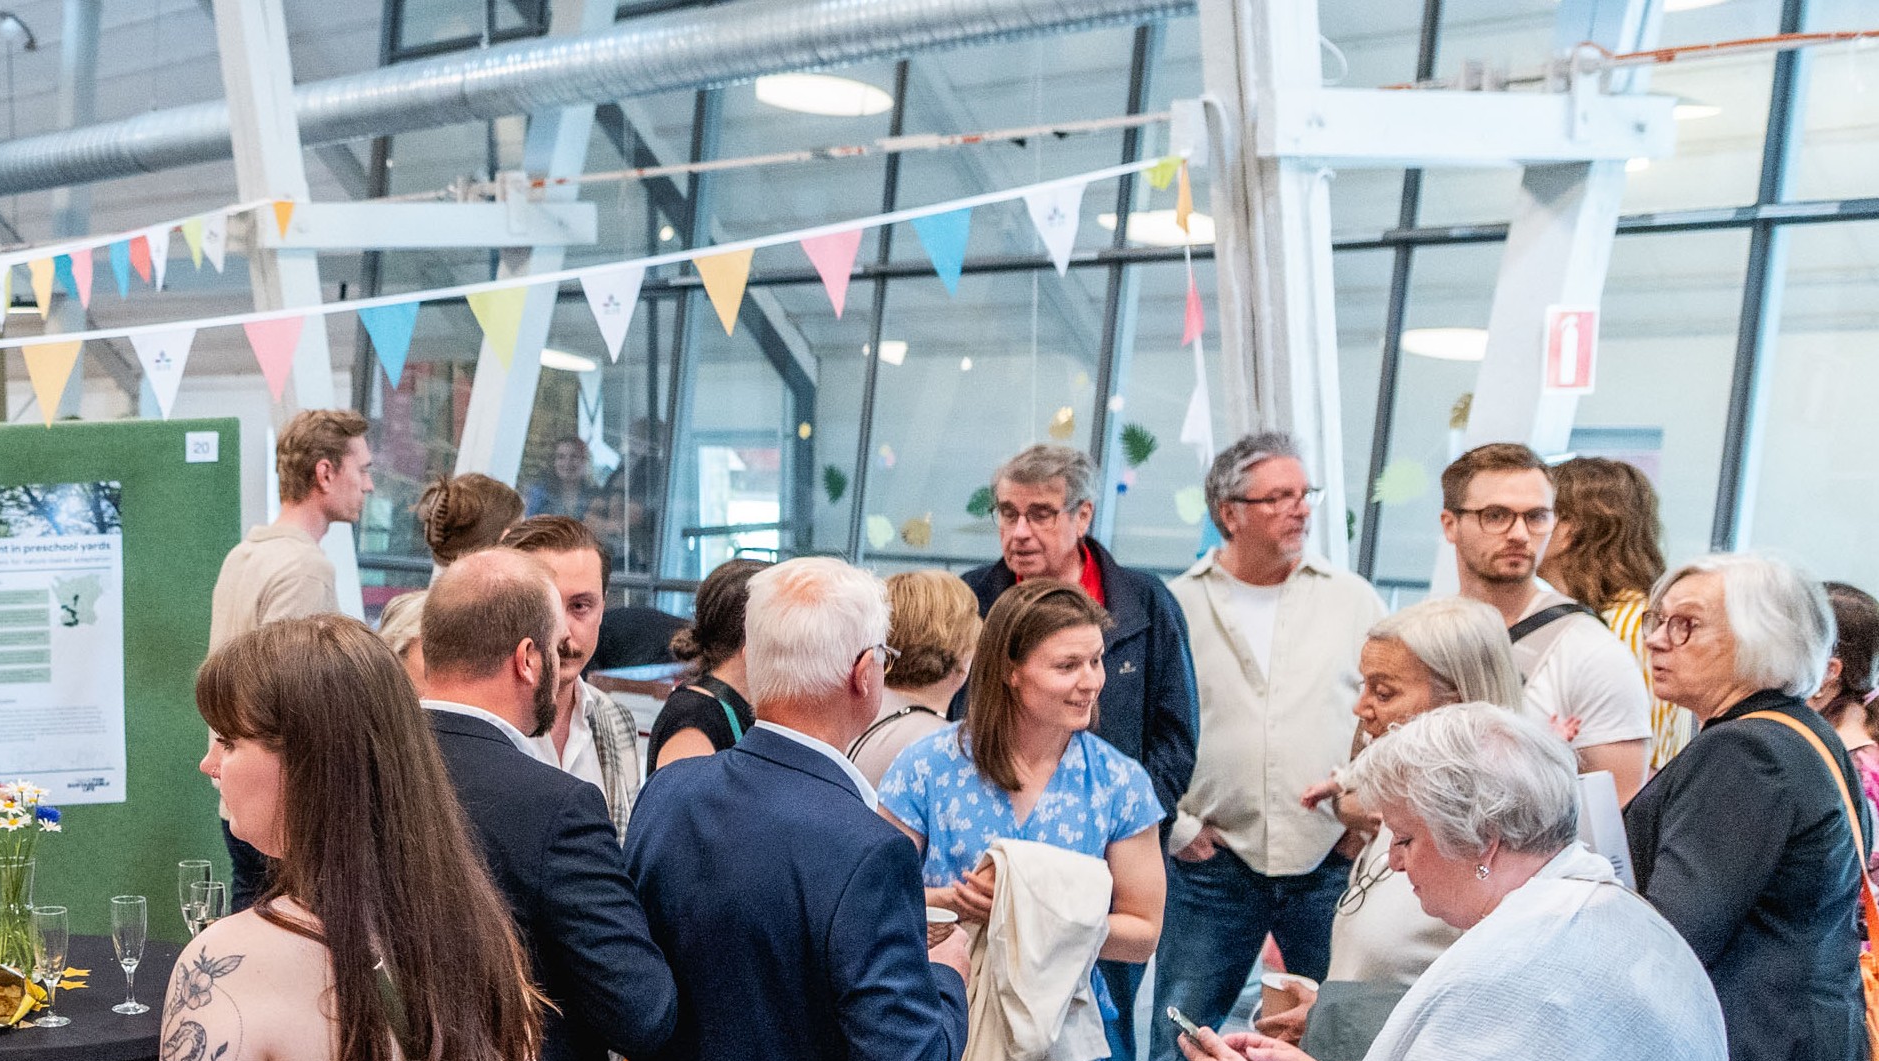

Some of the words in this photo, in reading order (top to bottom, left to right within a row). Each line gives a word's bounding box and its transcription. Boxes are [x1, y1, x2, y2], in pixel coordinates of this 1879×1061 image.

[193, 441, 210, 454] 20
[24, 543, 78, 554] preschool
[81, 542, 111, 552] yards
